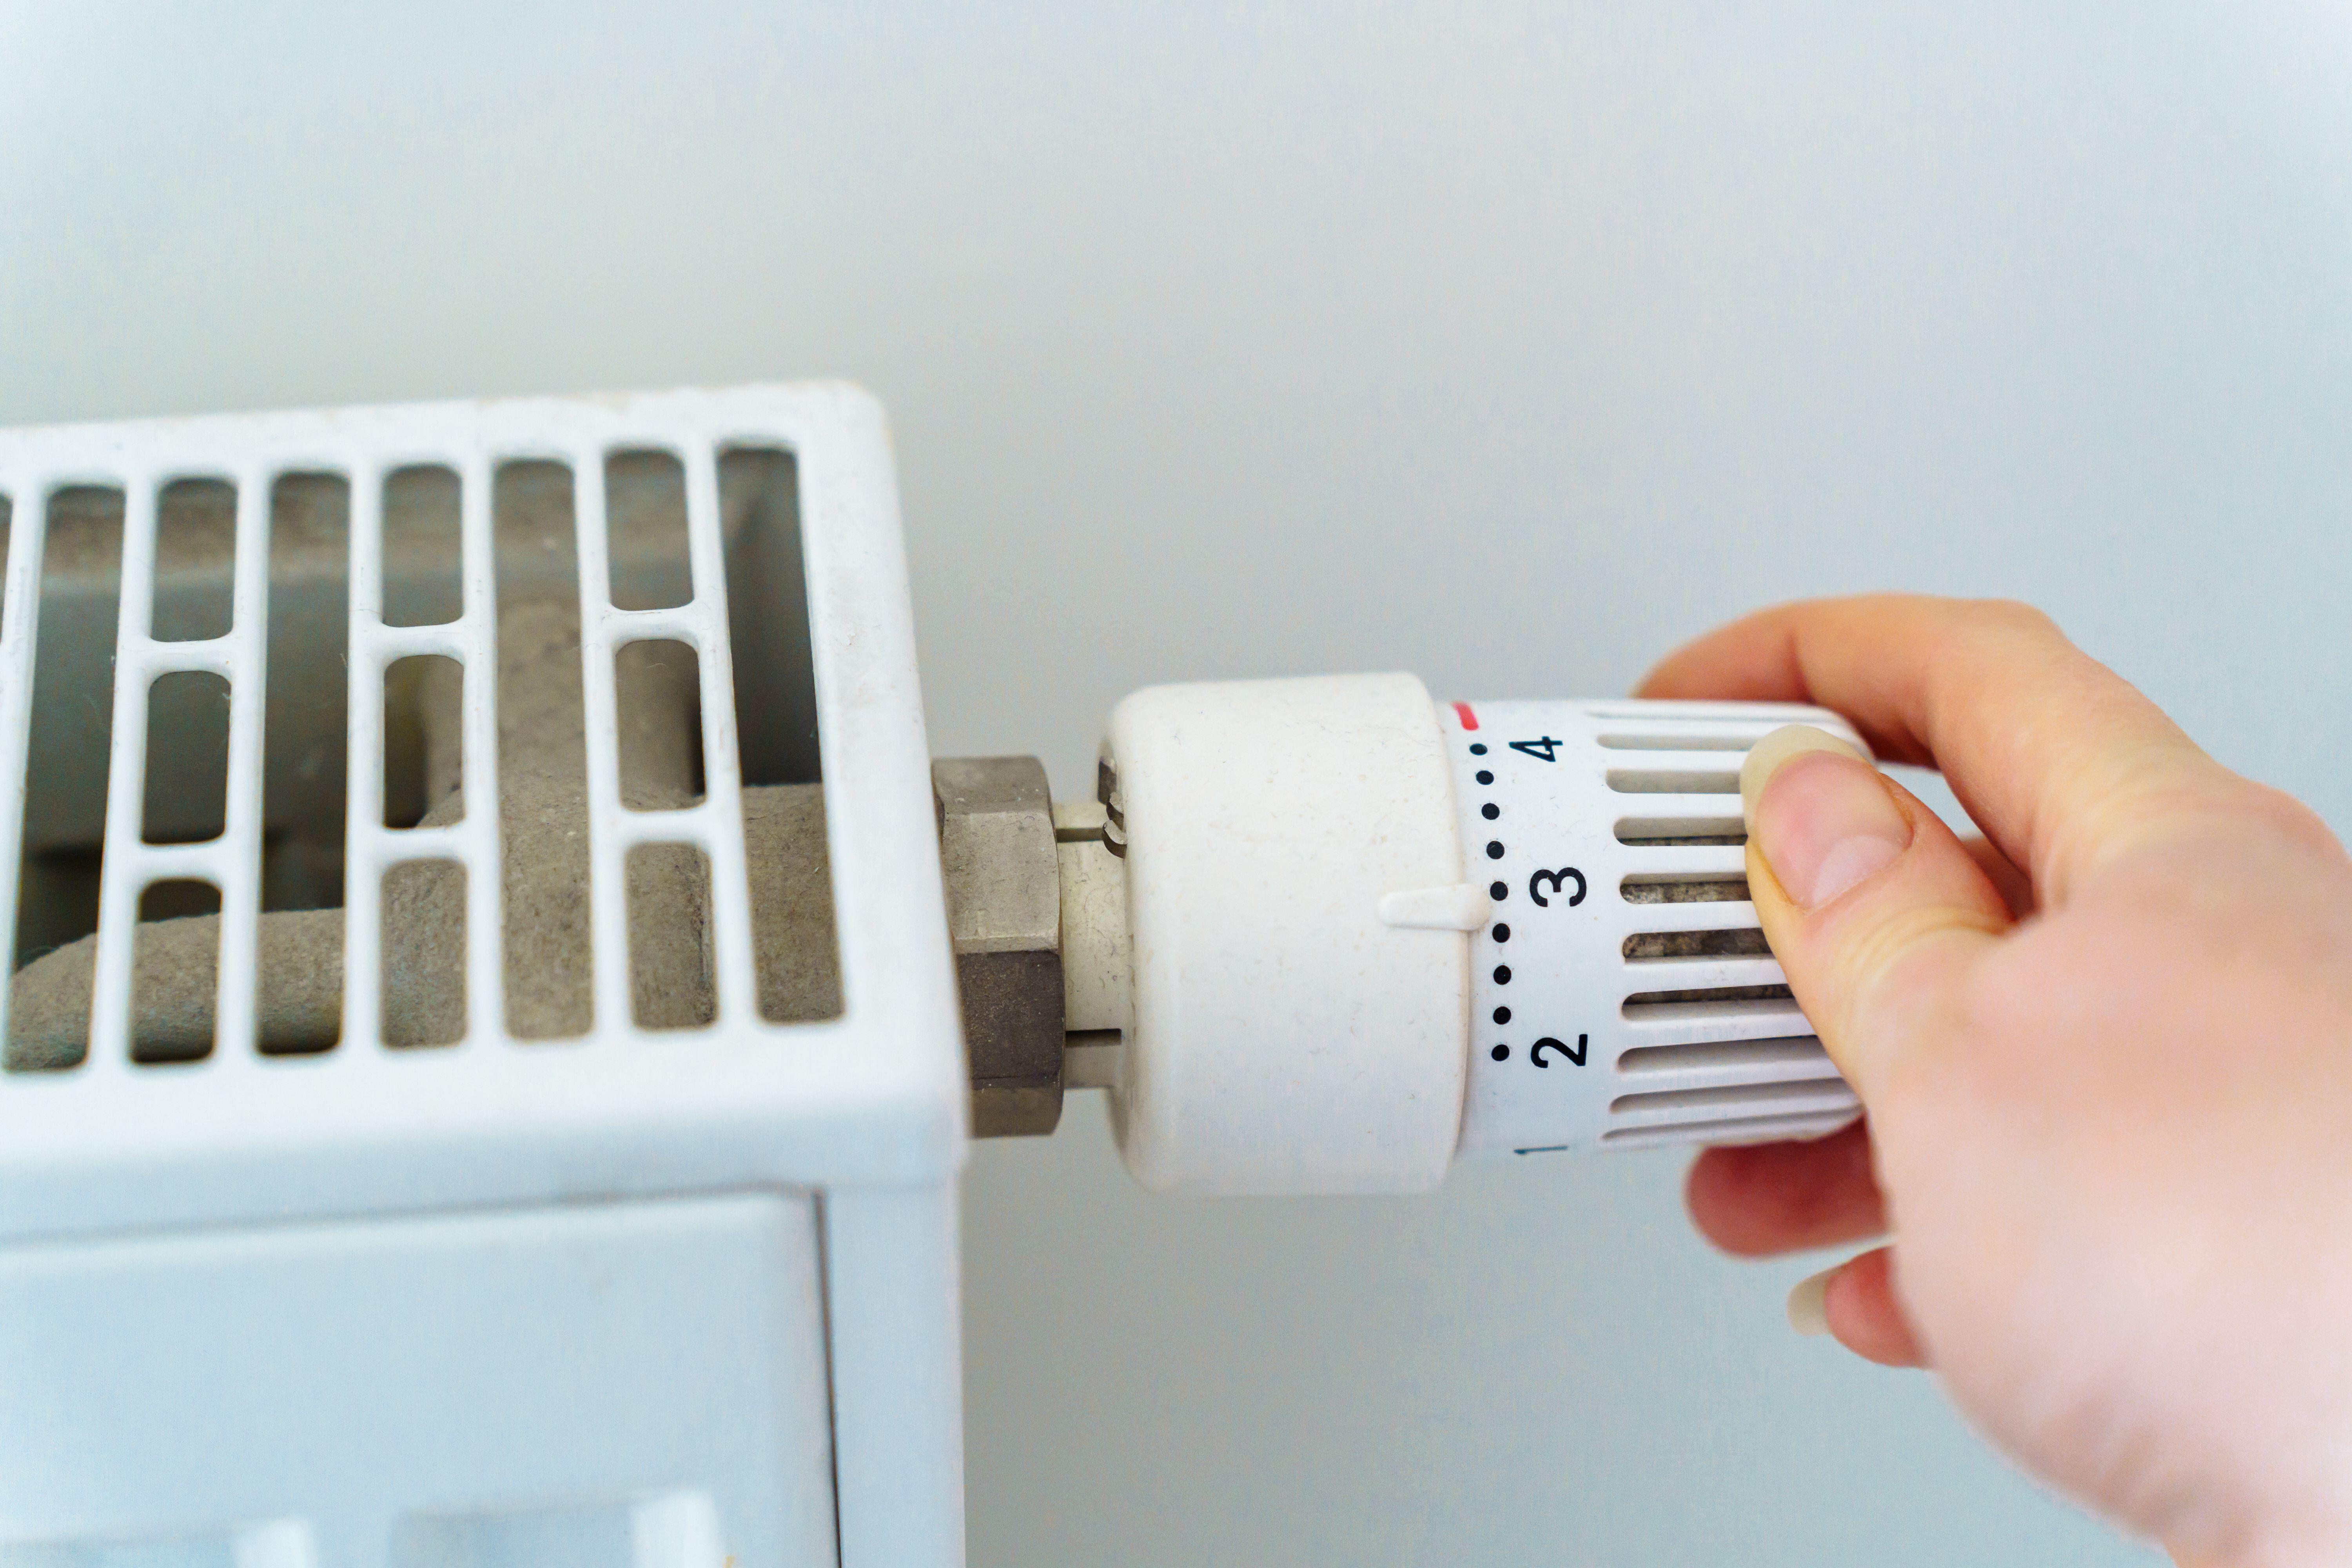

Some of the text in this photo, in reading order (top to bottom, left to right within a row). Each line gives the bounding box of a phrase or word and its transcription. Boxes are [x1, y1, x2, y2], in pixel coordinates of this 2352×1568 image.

[1508, 736, 1563, 762] 4
[1529, 867, 1587, 907] 3
[1530, 1034, 1588, 1069] 2
